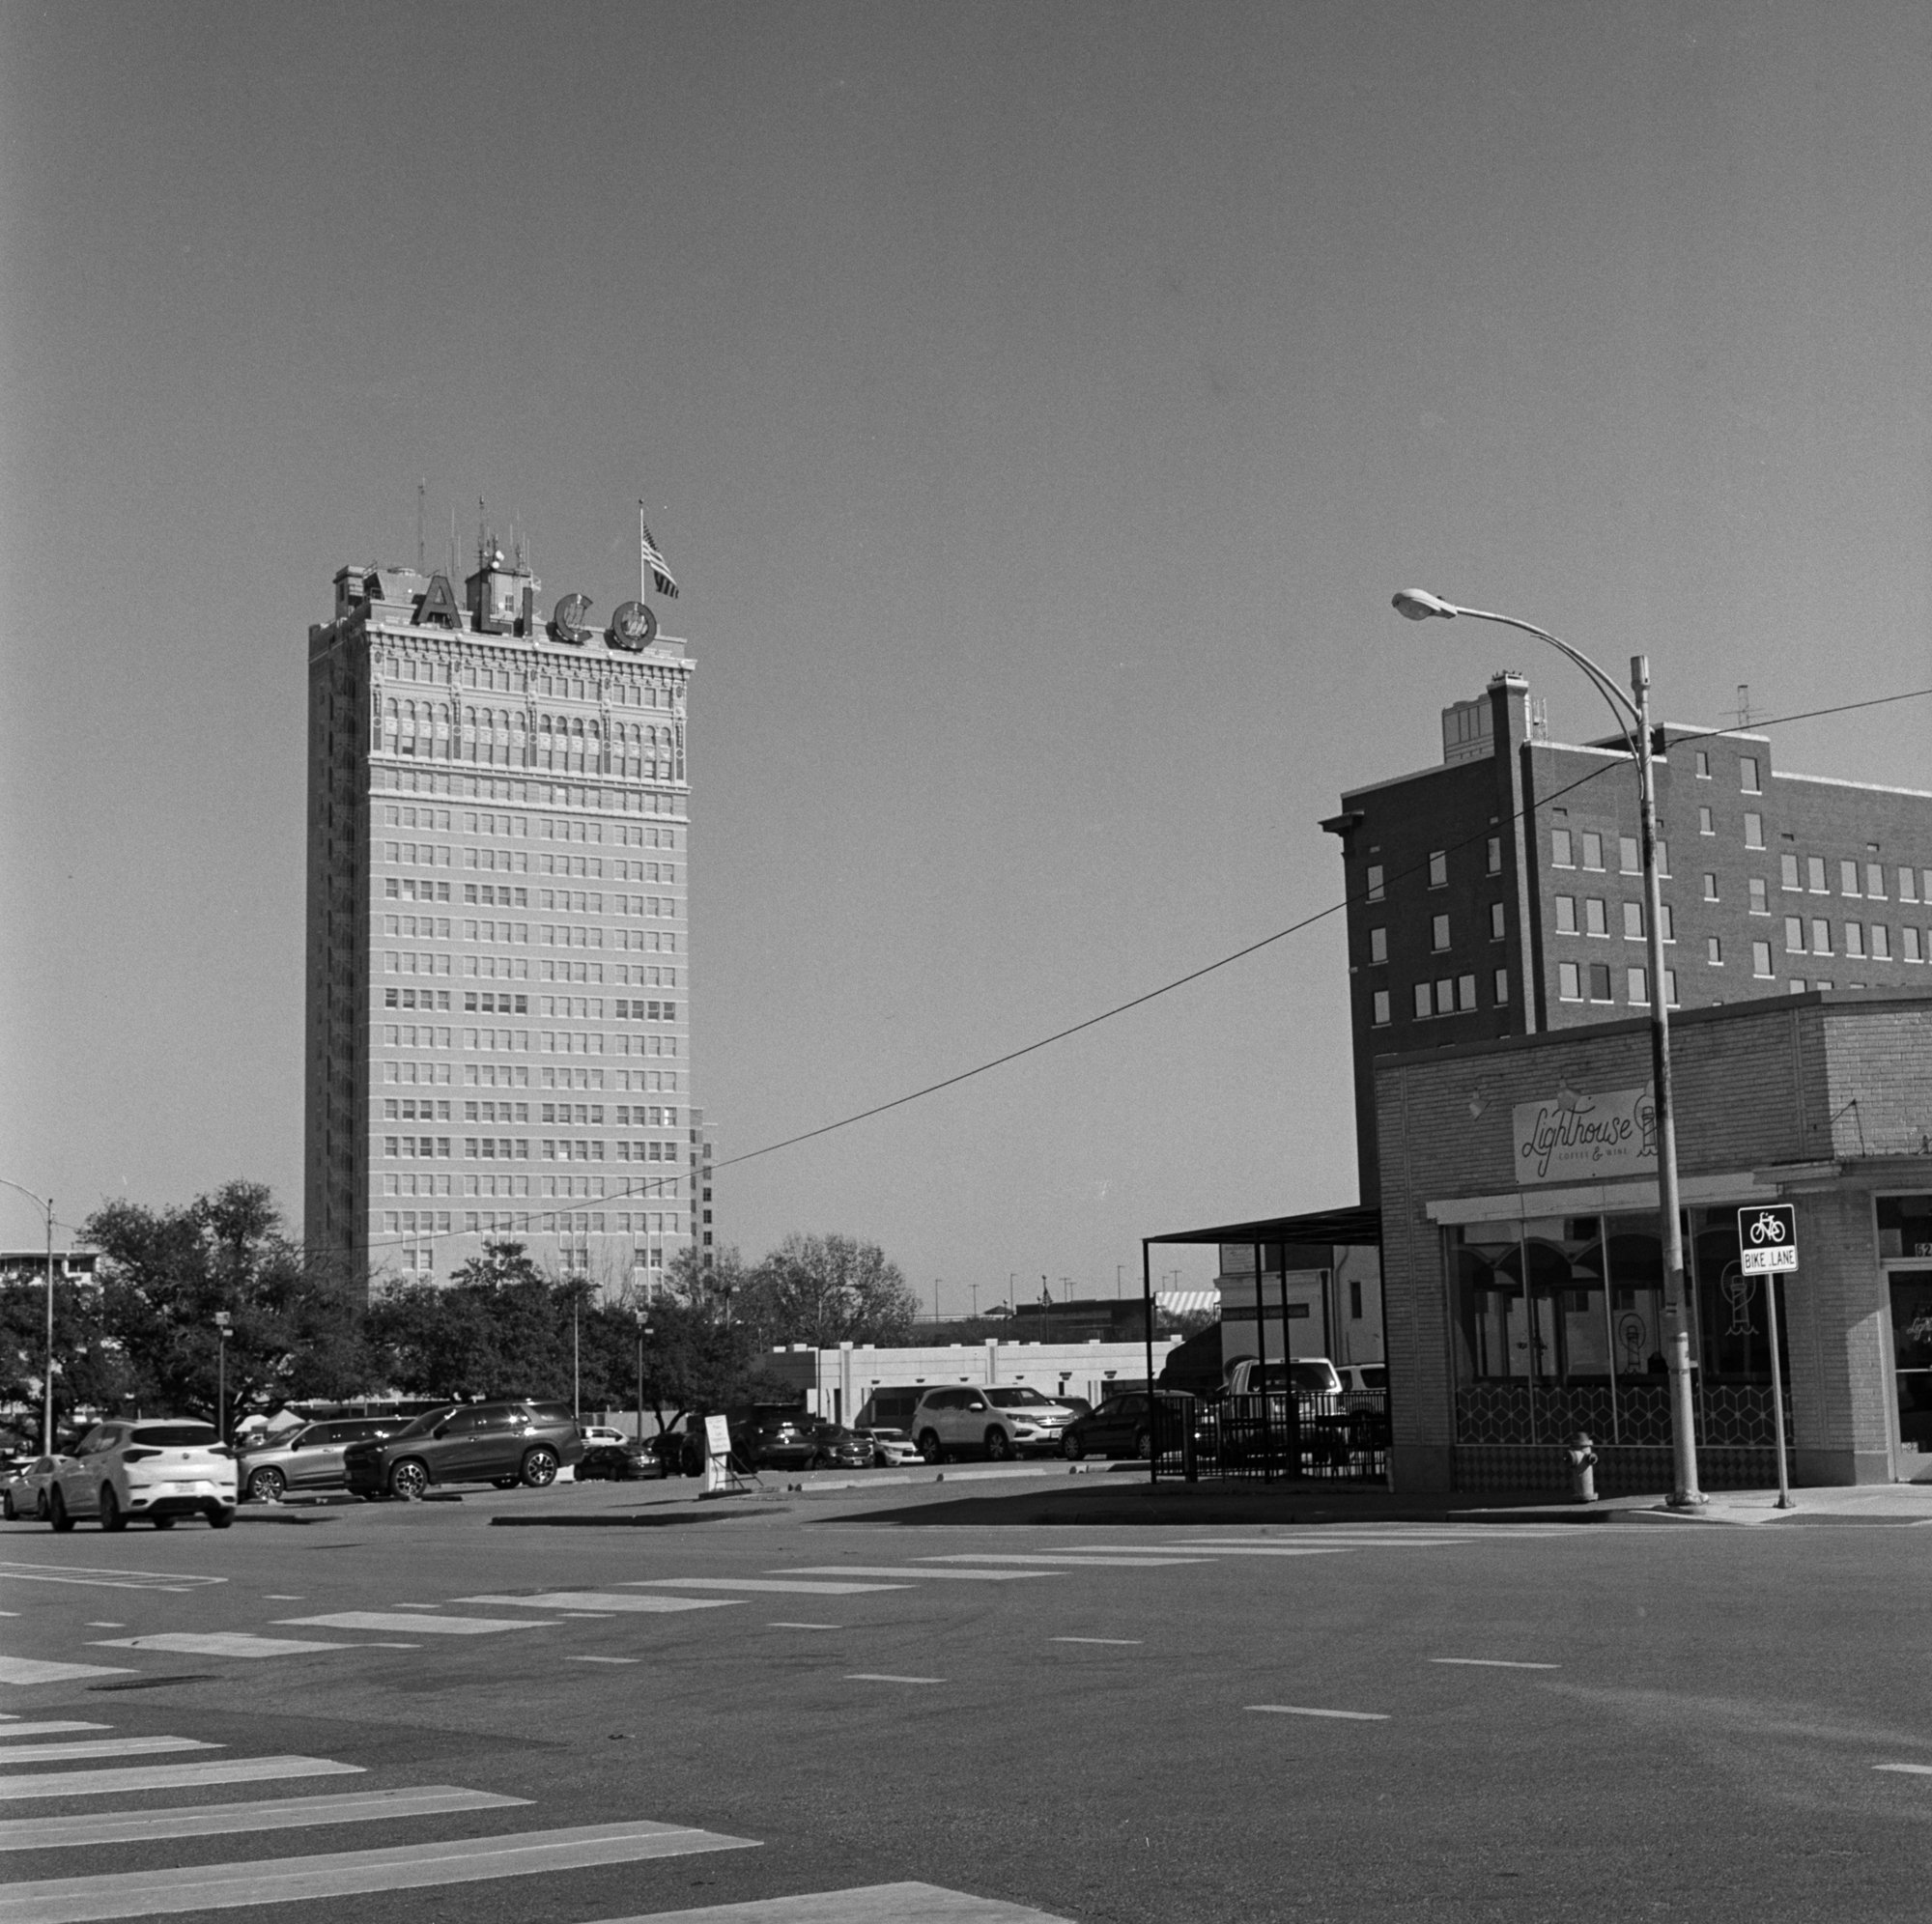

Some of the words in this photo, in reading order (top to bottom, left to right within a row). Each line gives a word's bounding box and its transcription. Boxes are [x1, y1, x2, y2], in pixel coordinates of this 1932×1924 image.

[416, 576, 657, 650] ALICO
[1521, 1105, 1633, 1177] Lighthouse
[1592, 1146, 1604, 1162] &
[1605, 1146, 1628, 1157] WINE
[1745, 1252, 1766, 1269] BIKE
[1771, 1249, 1795, 1266] LANE
